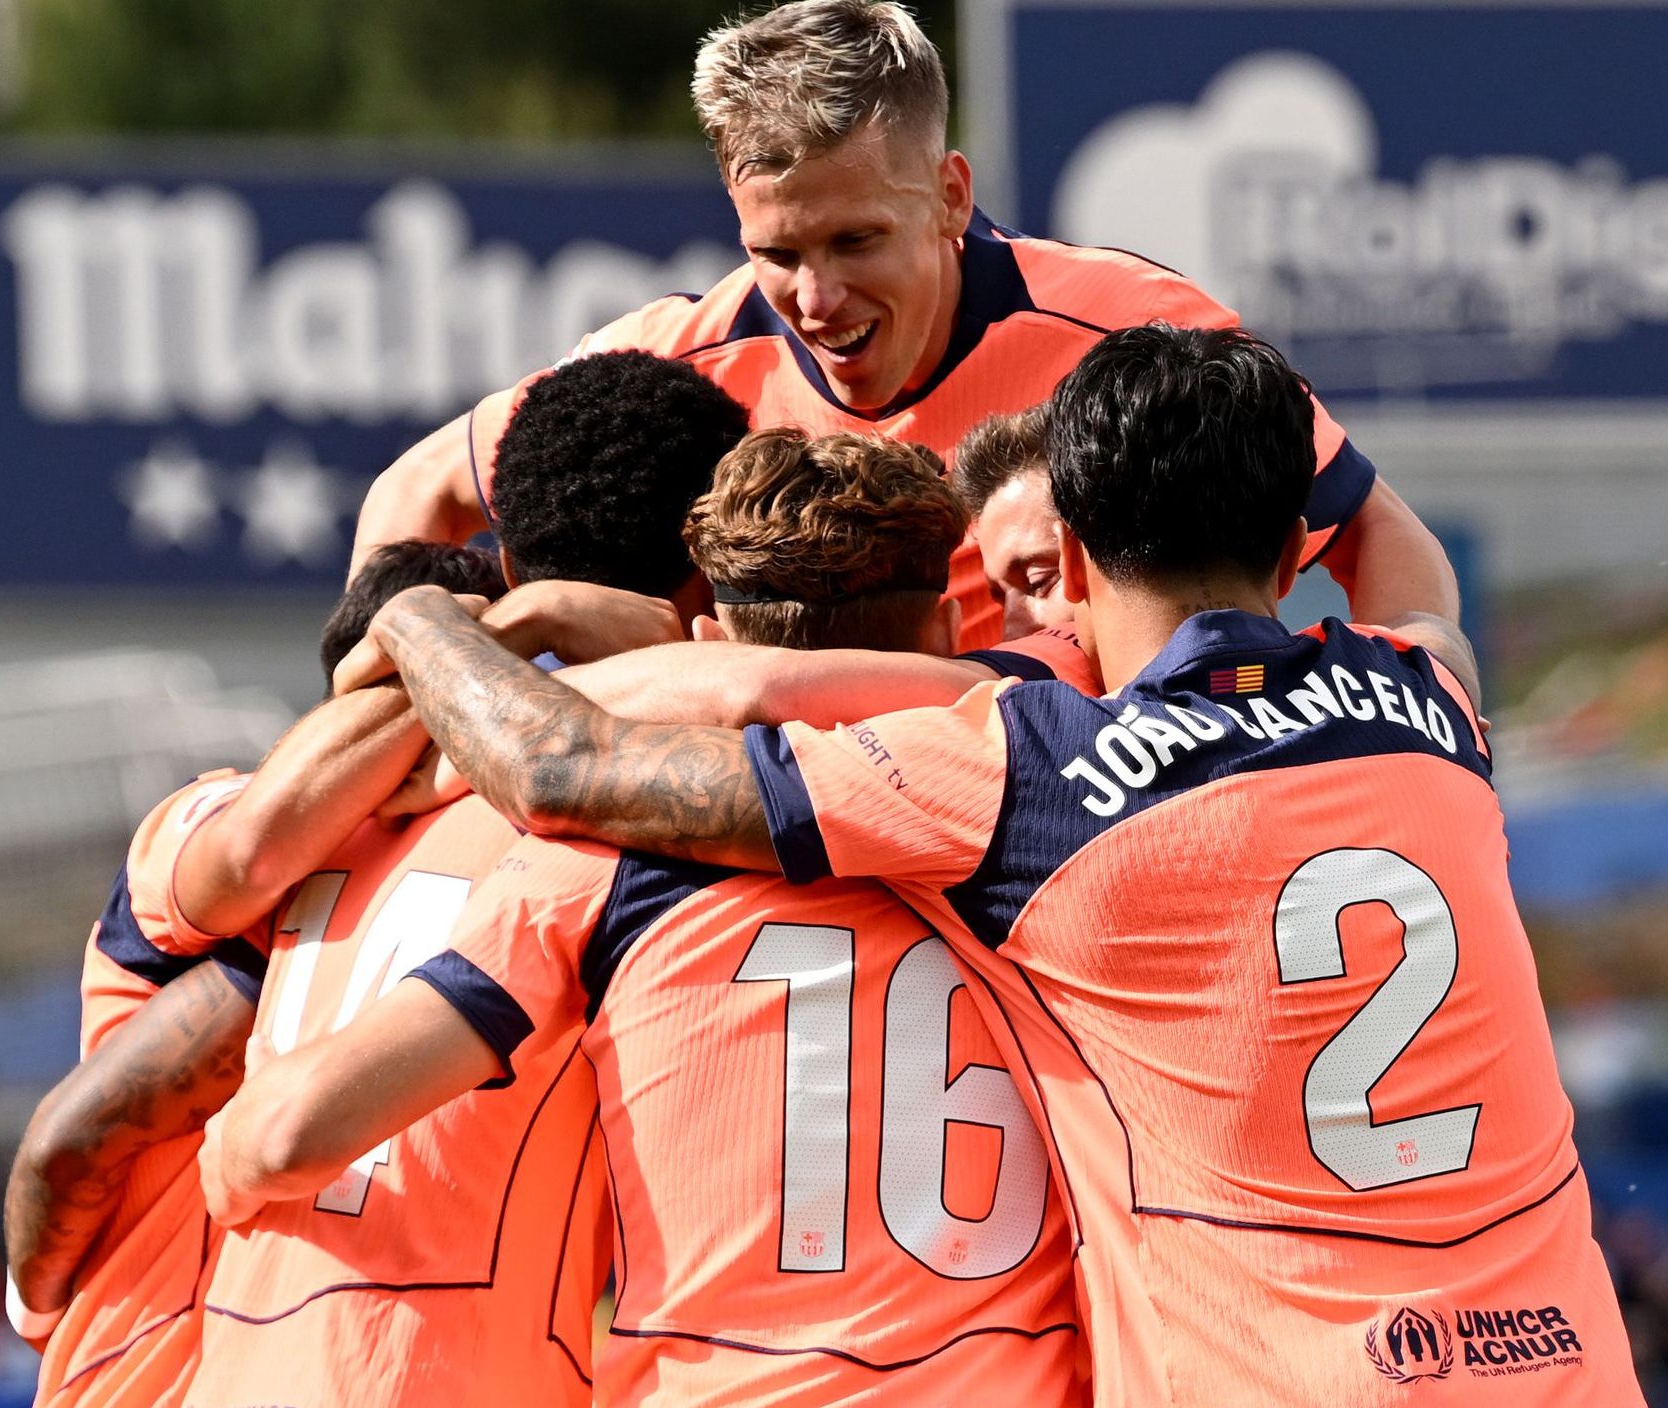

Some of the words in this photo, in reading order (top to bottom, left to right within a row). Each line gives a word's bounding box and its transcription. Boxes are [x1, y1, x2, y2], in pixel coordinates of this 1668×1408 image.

[0, 182, 737, 418] Maho
[1060, 703, 1226, 817] JOÃO
[1221, 664, 1457, 755] CANCELO
[1273, 846, 1483, 1193] 2
[732, 920, 1050, 1281] 16
[1455, 1306, 1570, 1338] UNHCR
[1463, 1329, 1583, 1366] ACNUR
[1469, 1368, 1489, 1378] The
[1490, 1367, 1507, 1377] UN
